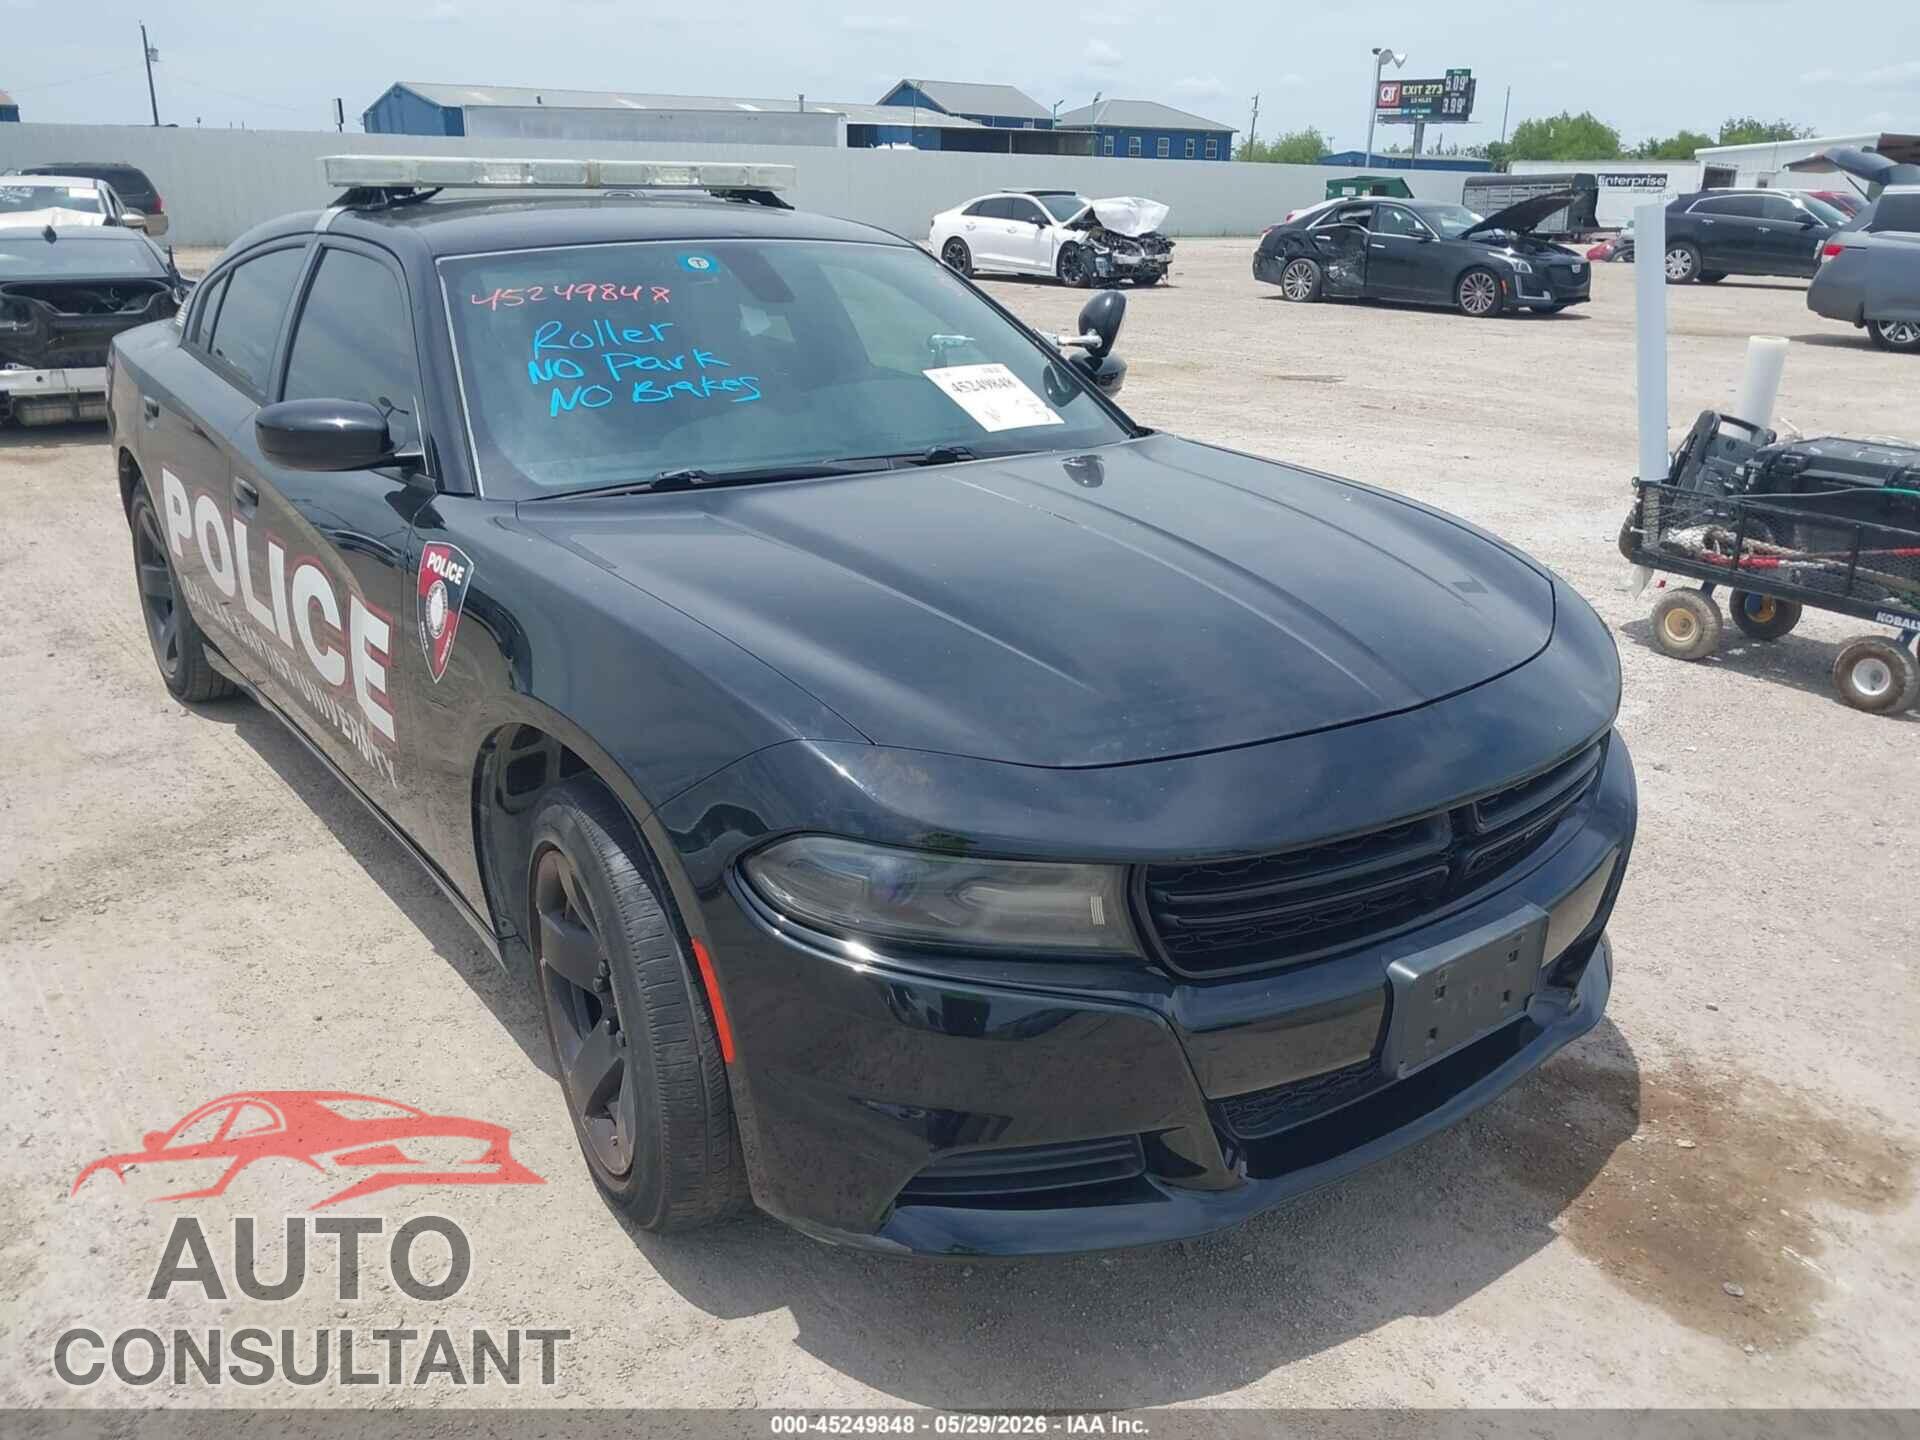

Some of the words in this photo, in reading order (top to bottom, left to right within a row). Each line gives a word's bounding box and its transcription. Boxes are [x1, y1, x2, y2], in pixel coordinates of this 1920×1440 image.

[1381, 86, 1398, 101] QT
[1402, 85, 1423, 95] EXIT
[1425, 84, 1443, 95] 273
[1599, 175, 1666, 188] Enterprise
[533, 319, 674, 359] Roller
[528, 358, 584, 385] NO
[549, 384, 613, 417] NO
[426, 551, 465, 586] POLICE
[162, 467, 396, 742] POLICE
[295, 669, 398, 789] UNIVERSITY
